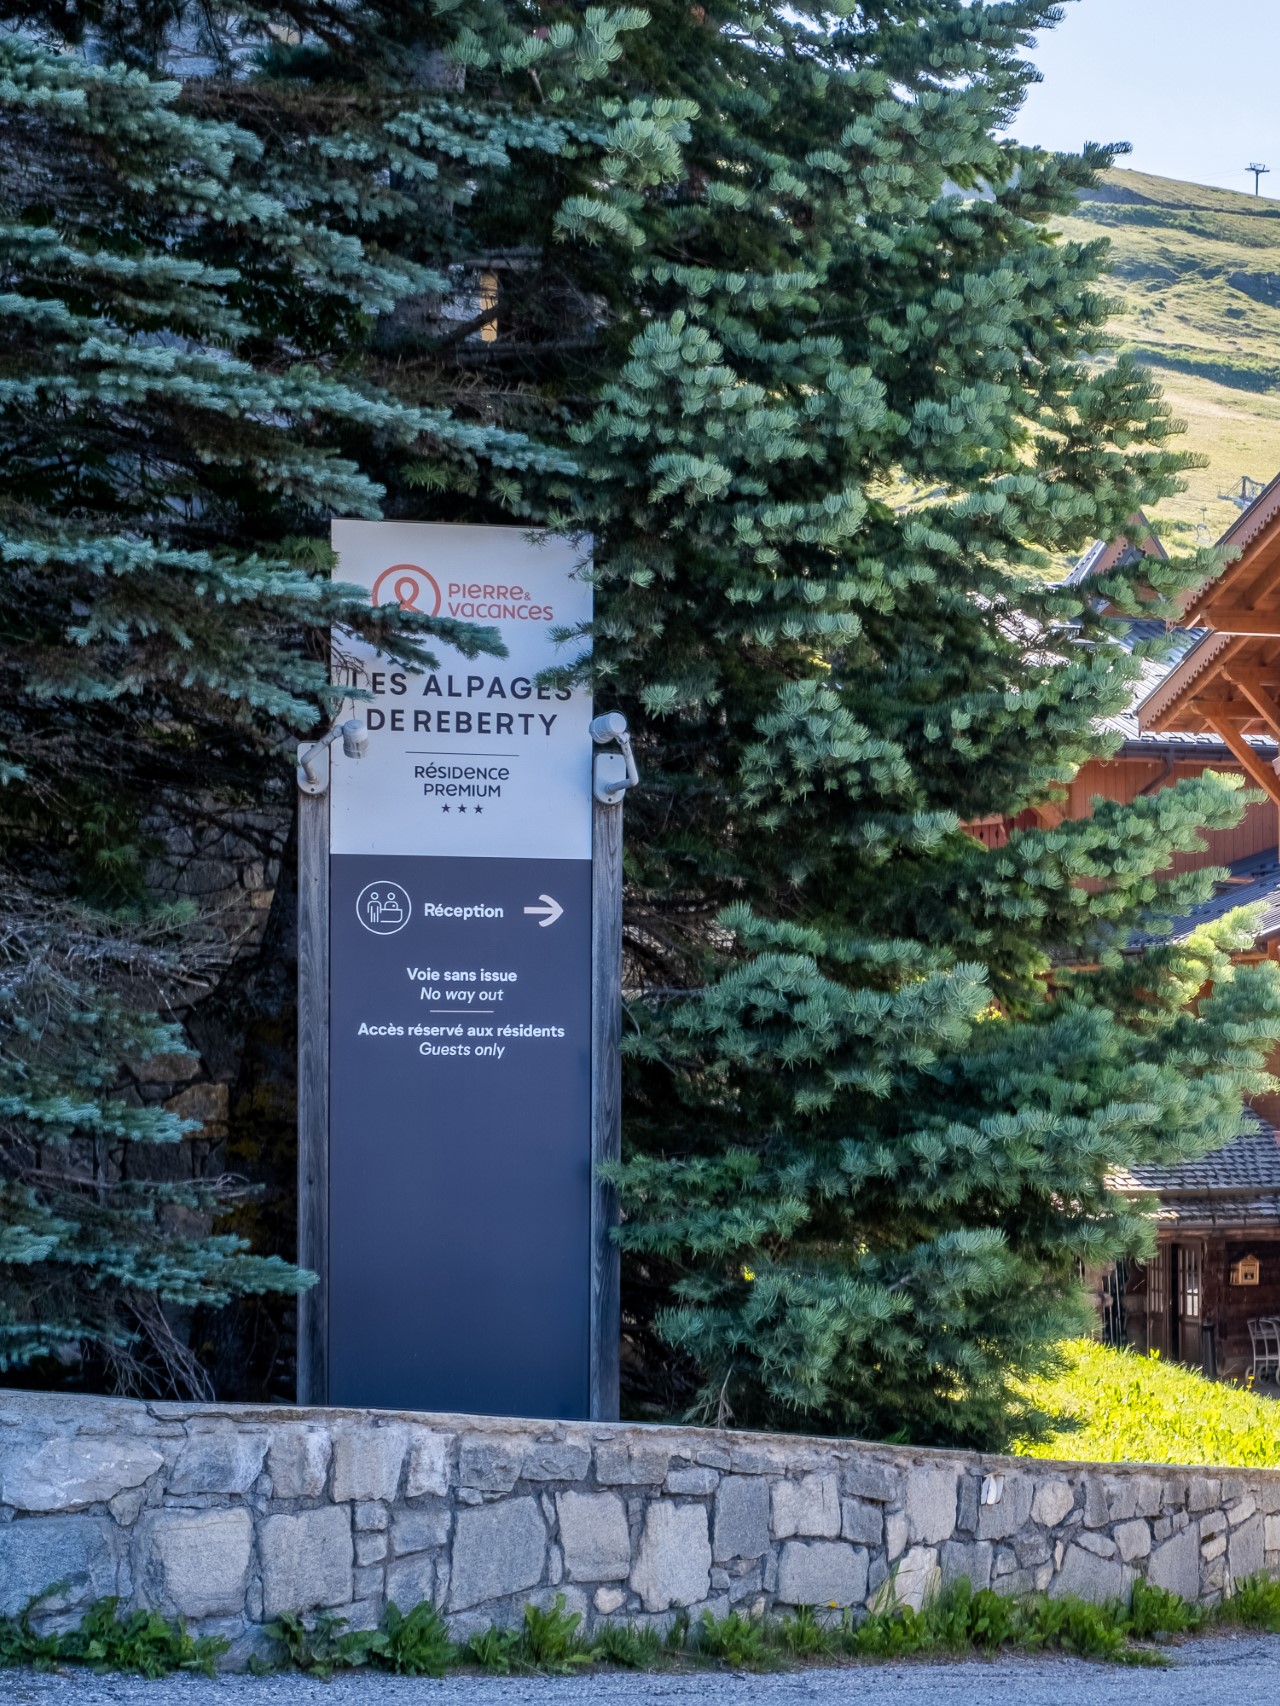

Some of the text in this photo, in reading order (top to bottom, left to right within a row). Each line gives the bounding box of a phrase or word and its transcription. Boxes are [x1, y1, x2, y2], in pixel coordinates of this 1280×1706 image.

[367, 709, 557, 735] DE REBERTY
[424, 903, 504, 920] Réception
[406, 968, 518, 982] Voie sans issue
[420, 987, 504, 1003] No way out
[357, 1023, 565, 1038] Accès réservé aux résidents
[419, 1042, 505, 1059] Guests only
